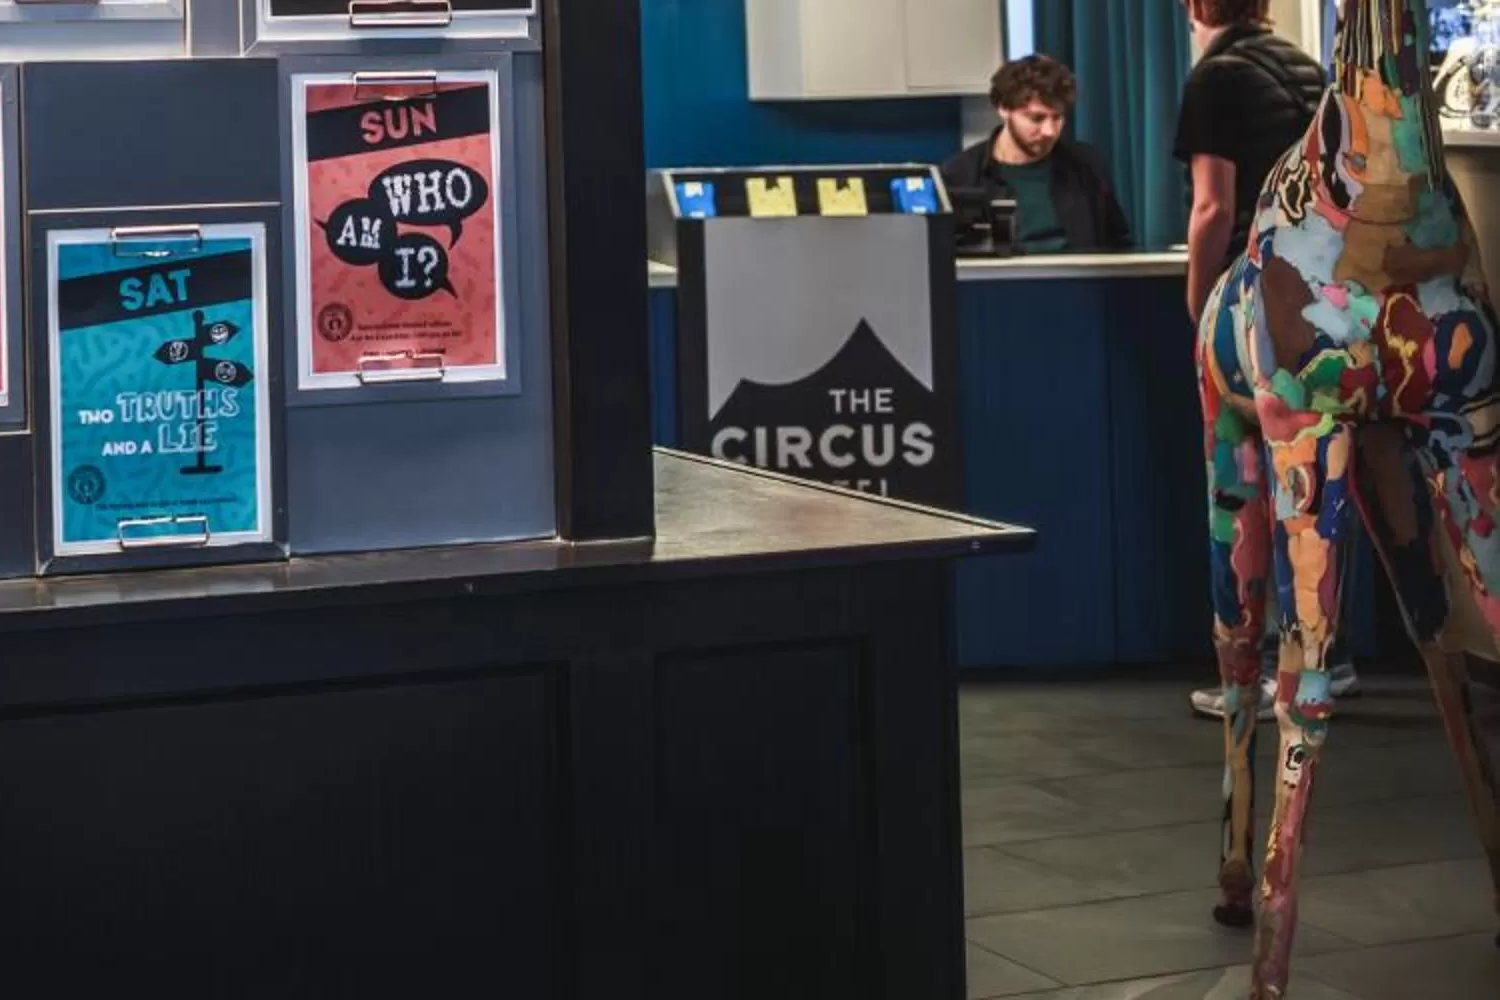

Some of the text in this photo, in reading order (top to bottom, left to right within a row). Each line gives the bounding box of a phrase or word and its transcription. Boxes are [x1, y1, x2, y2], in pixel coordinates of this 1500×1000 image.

[360, 103, 437, 144] SUN
[381, 167, 471, 217] WHO
[336, 215, 382, 249] AM
[395, 246, 438, 288] I?
[119, 269, 190, 311] SAT
[78, 387, 240, 425] TWO TRUTHS
[829, 387, 894, 414] THE
[102, 422, 217, 457] AND A LIE
[711, 422, 934, 468] CIRCUS
